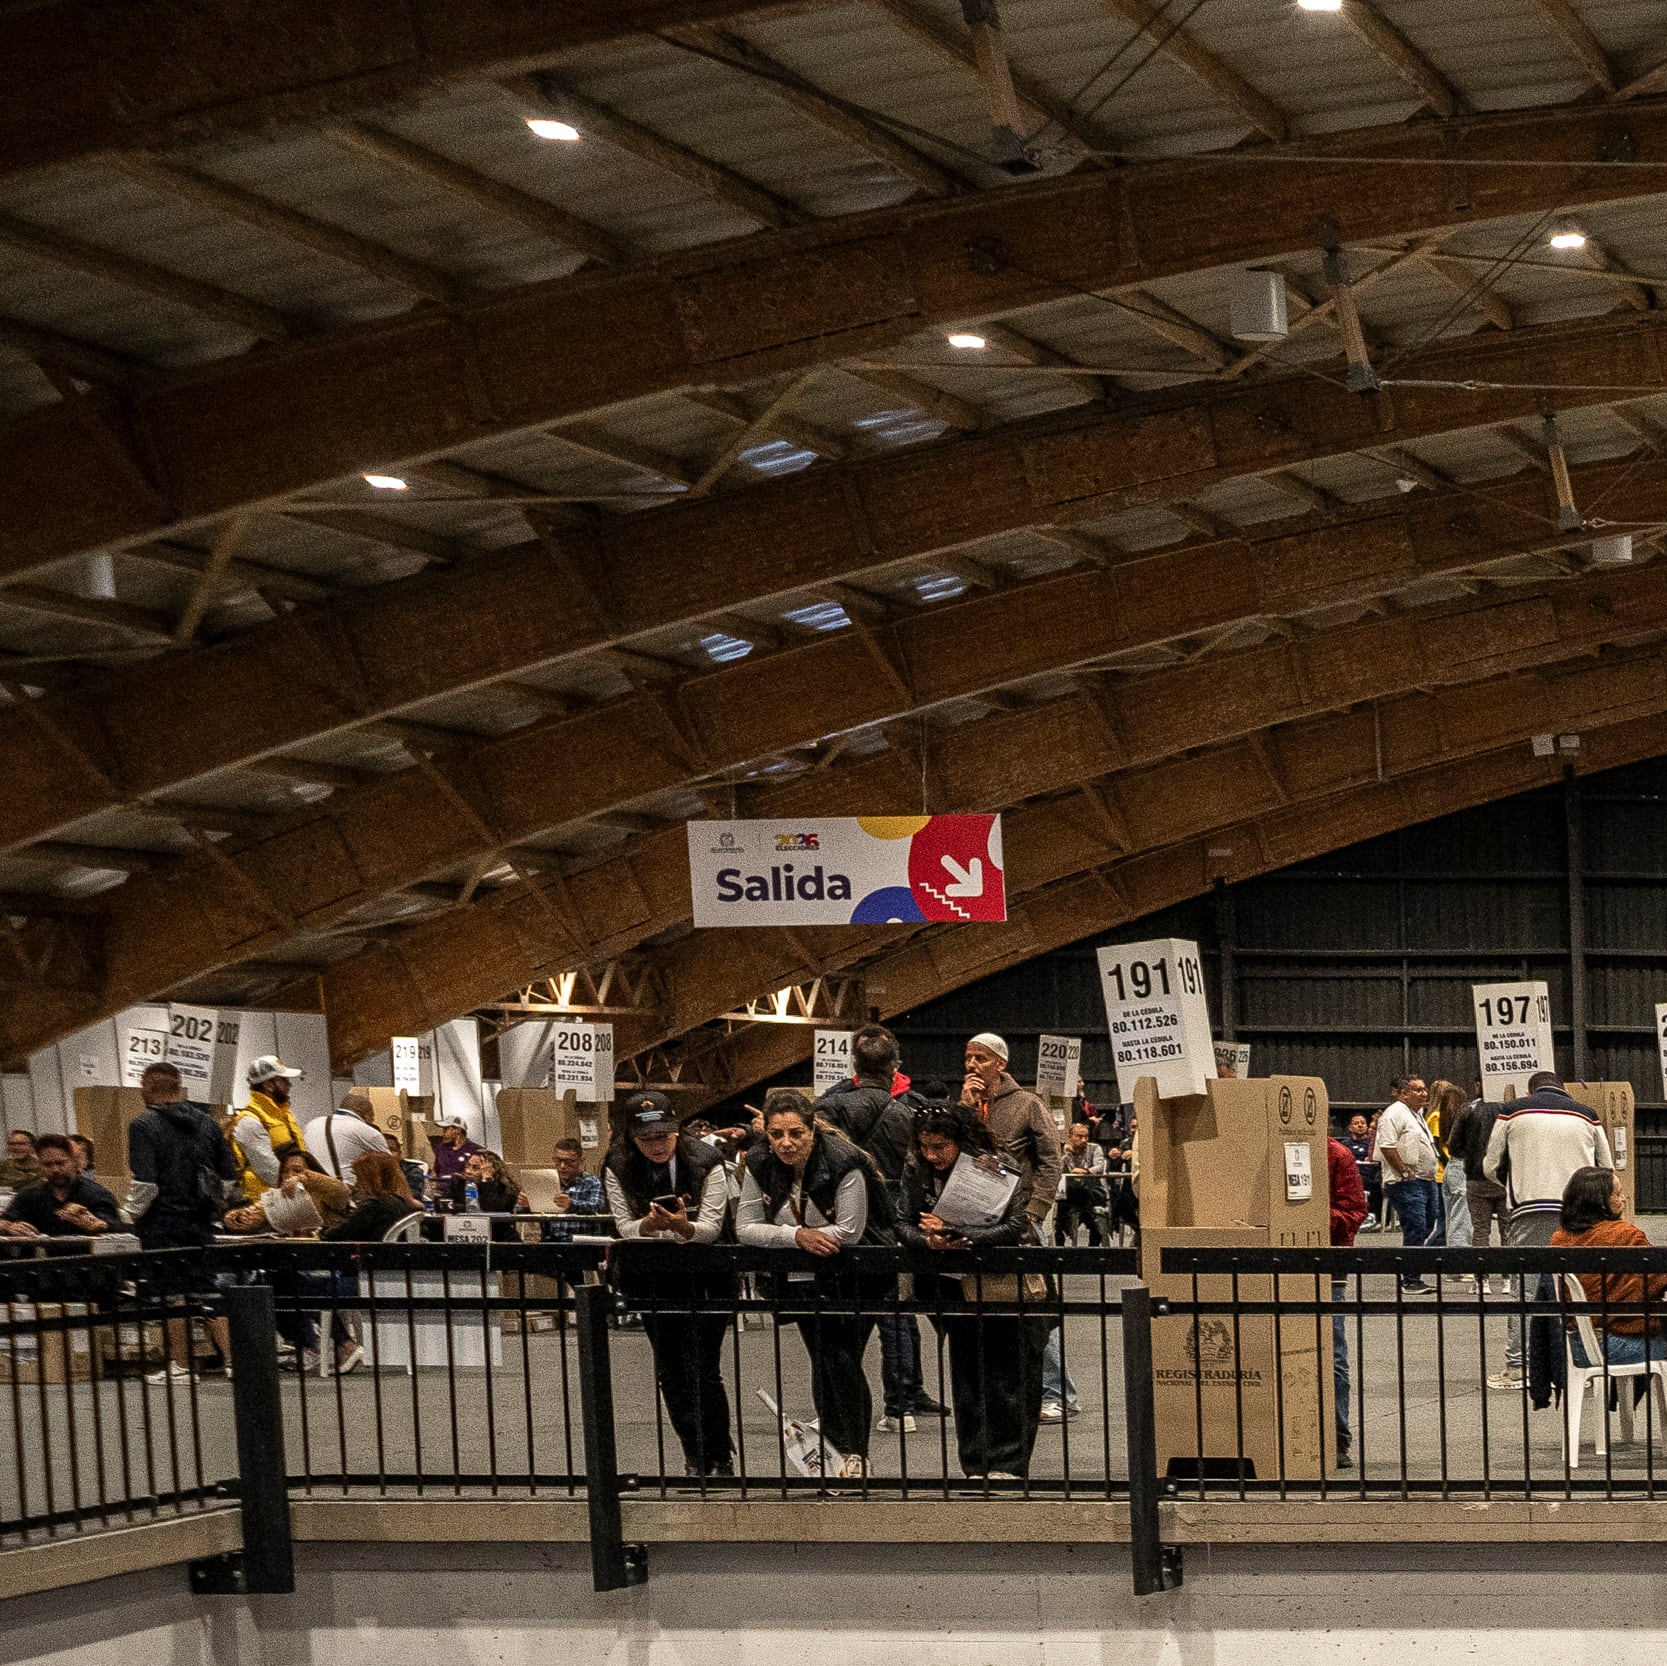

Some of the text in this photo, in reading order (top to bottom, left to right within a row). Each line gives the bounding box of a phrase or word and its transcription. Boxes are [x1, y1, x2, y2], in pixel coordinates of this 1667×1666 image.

[716, 863, 852, 903] Salida
[1108, 956, 1172, 1001] 191
[1177, 955, 1203, 996] 191
[1479, 995, 1531, 1027] 197
[170, 1013, 213, 1044] 202
[1112, 1014, 1179, 1034] 80.112.526
[129, 1036, 162, 1056] 213
[396, 1044, 418, 1060] 219
[558, 1031, 594, 1053] 208
[595, 1033, 613, 1053] 208
[816, 1037, 849, 1056] 214
[1041, 1042, 1067, 1059] 220
[1483, 1038, 1537, 1051] 80.150.011
[1117, 1042, 1183, 1063] 80.118.601
[1485, 1060, 1539, 1073] 80.156.694
